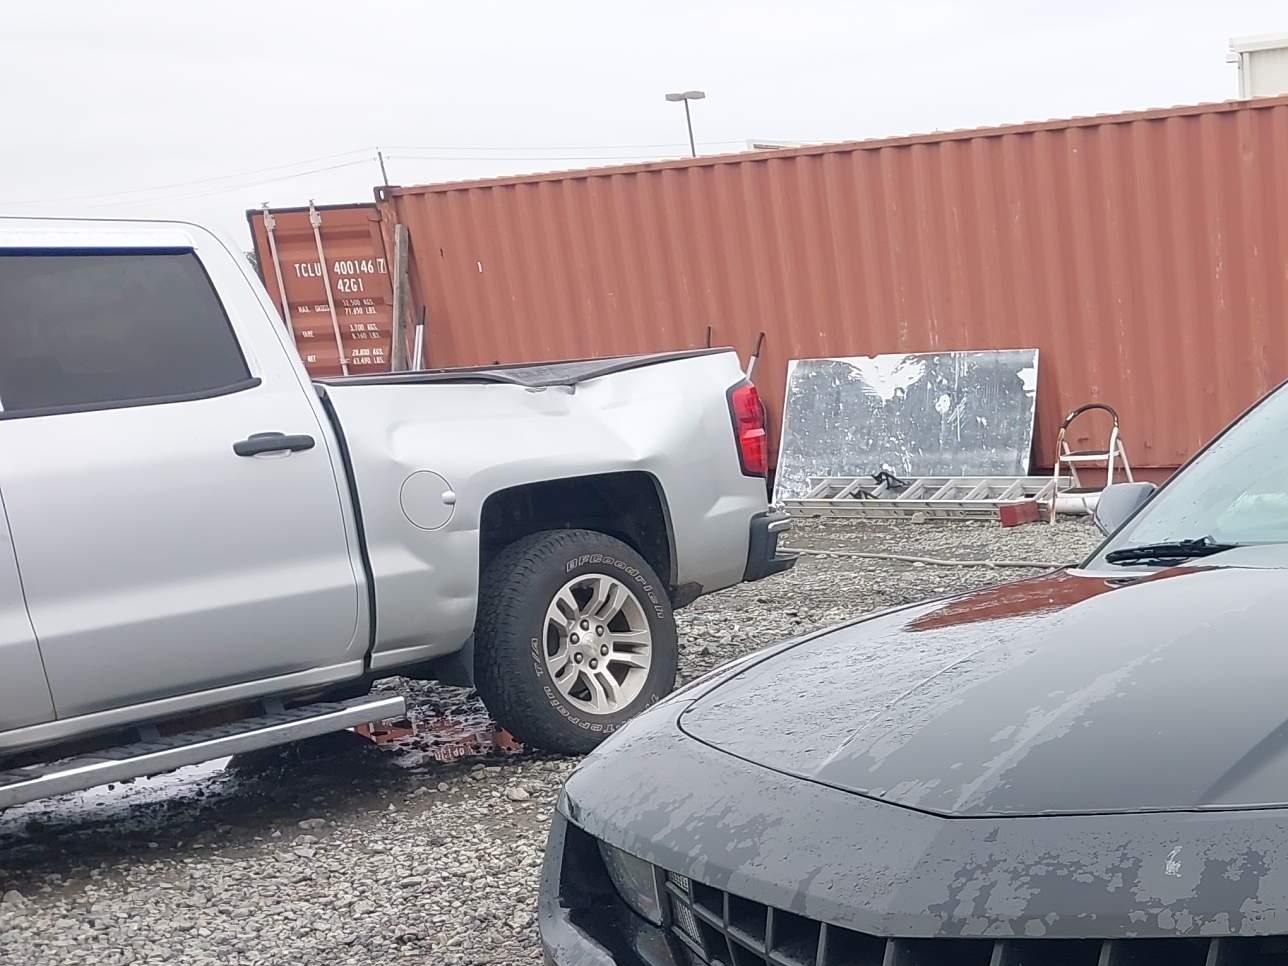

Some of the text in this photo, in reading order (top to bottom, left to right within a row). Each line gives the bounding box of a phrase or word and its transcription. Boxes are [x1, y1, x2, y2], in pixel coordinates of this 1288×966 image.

[294, 263, 321, 277] TCLU
[334, 260, 374, 275] 400146
[337, 278, 364, 292] 42G1
